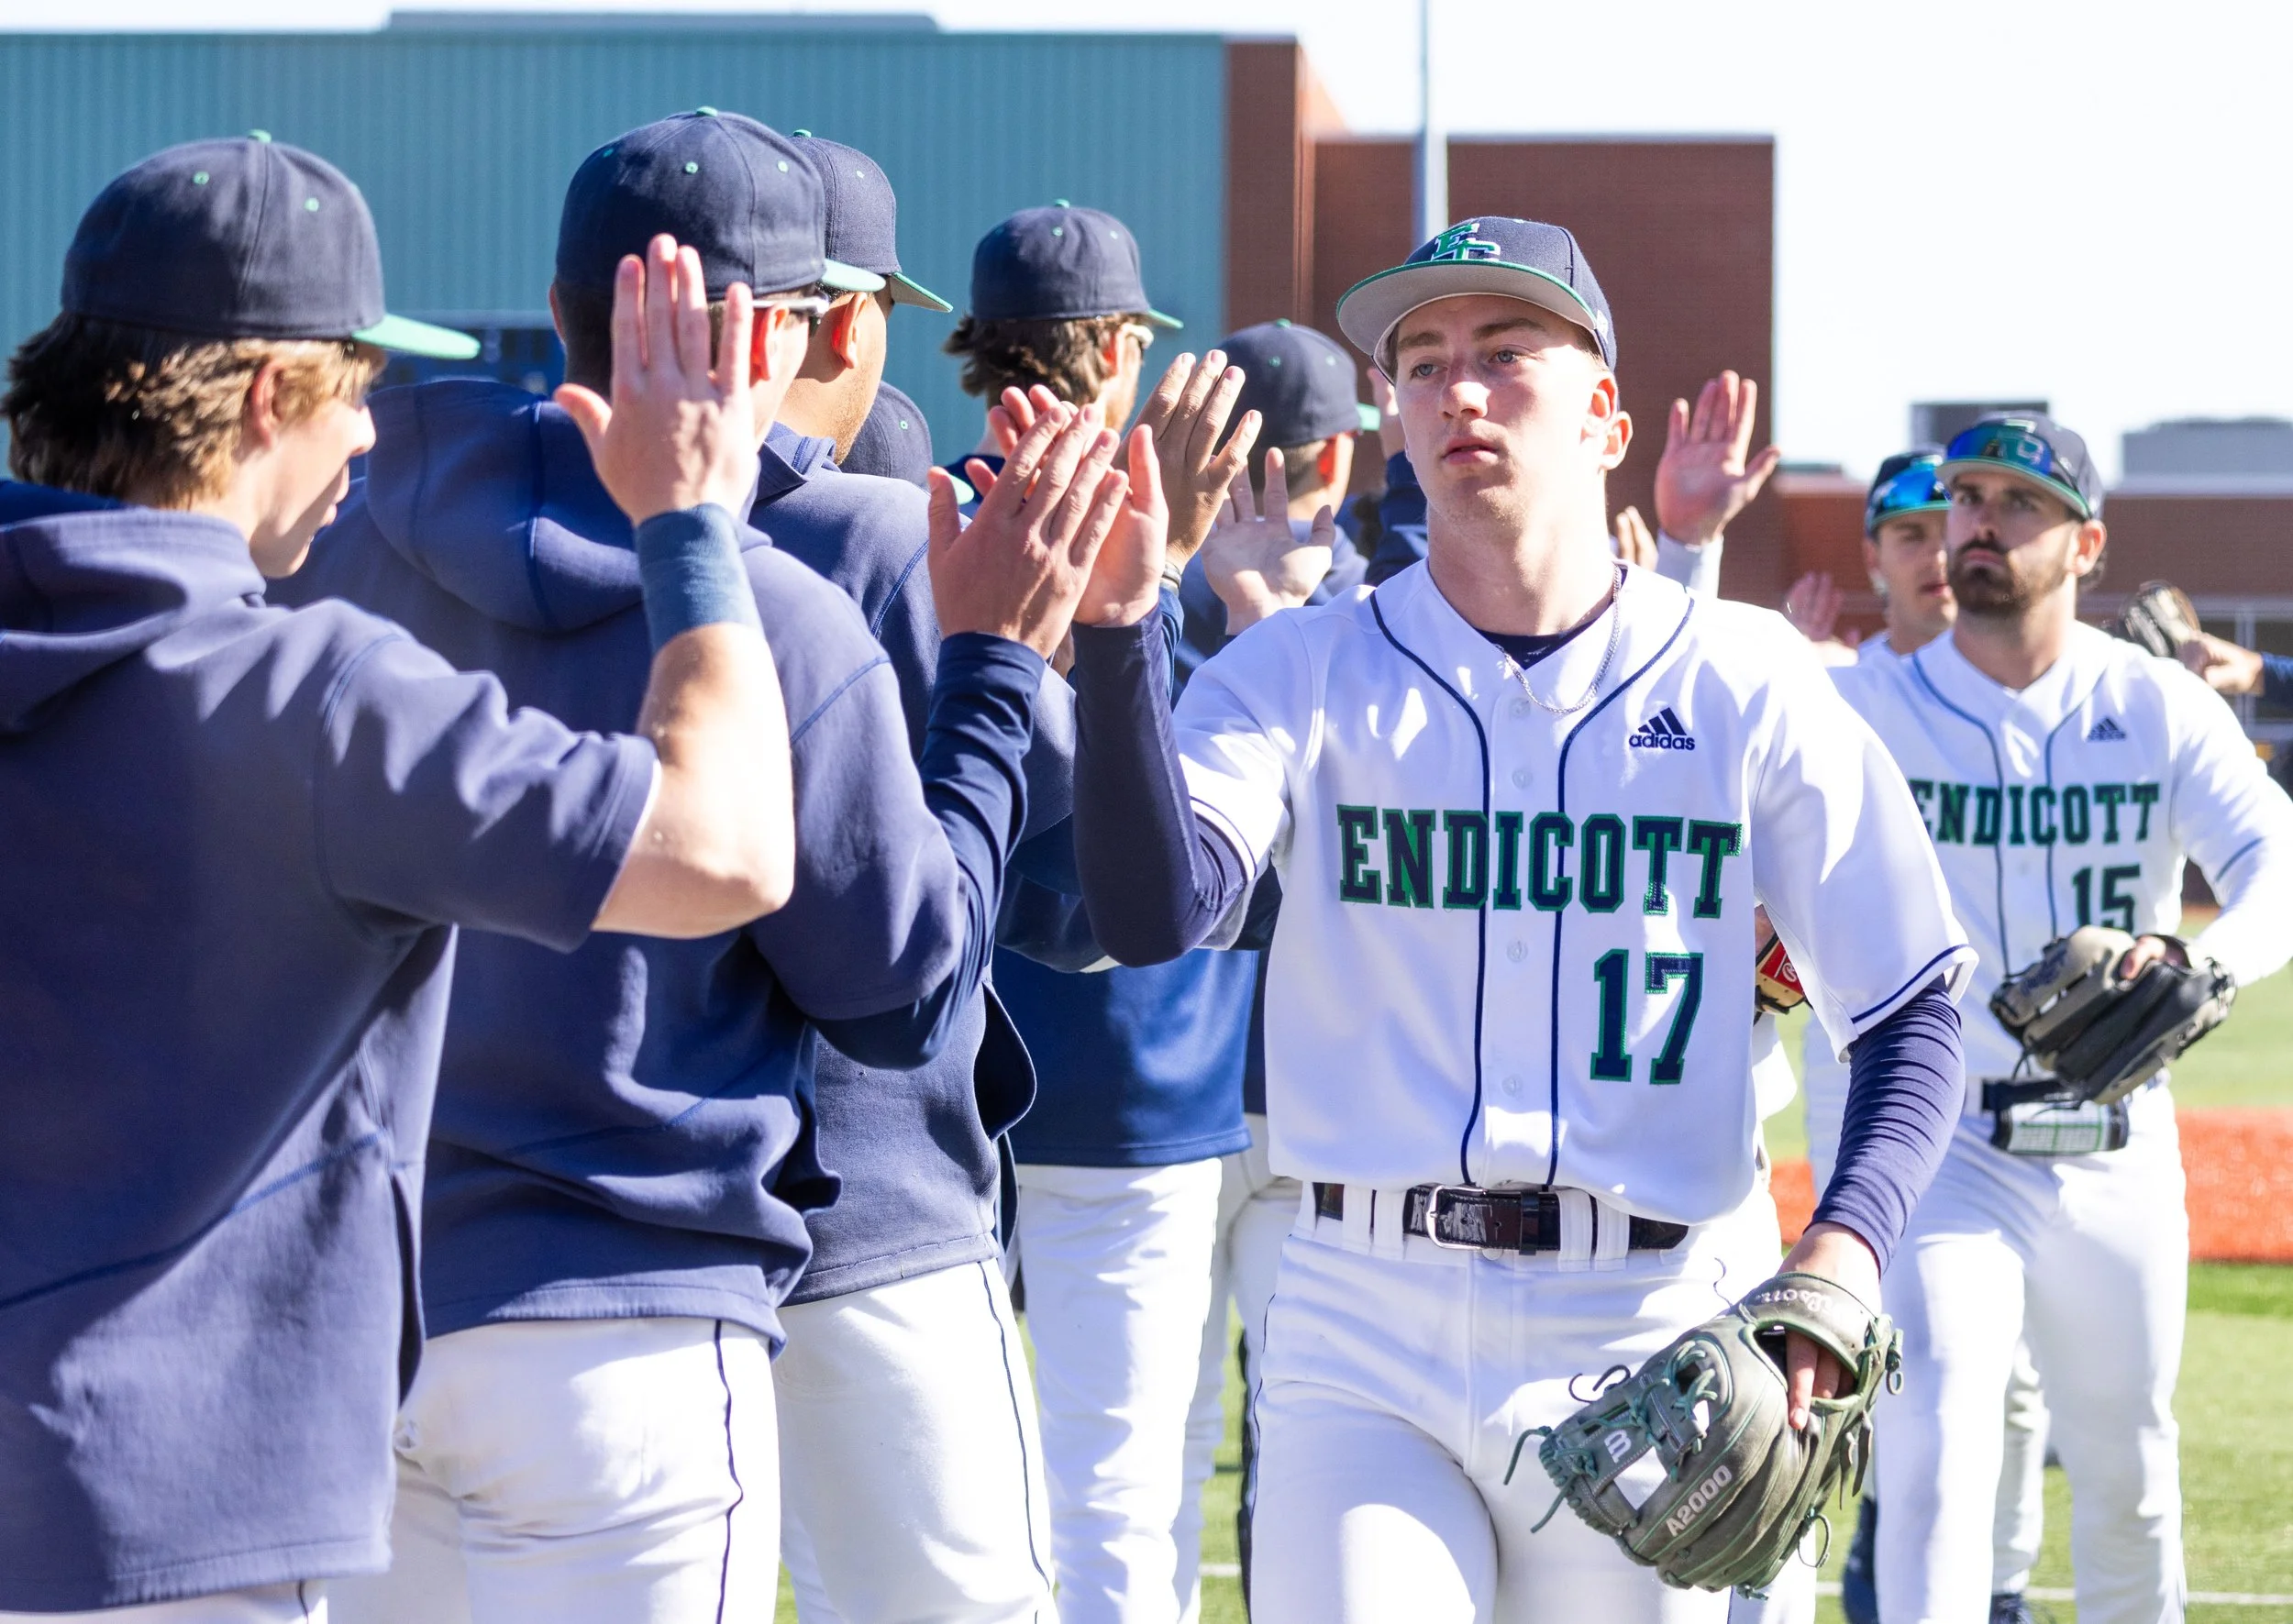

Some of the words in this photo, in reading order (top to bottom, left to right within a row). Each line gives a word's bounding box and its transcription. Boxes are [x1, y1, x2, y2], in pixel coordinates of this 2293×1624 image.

[1629, 732, 1695, 751] adidas
[1336, 804, 1743, 919] ENDICOTT
[2072, 864, 2140, 934] 15
[1590, 949, 1703, 1085] 17
[1760, 1288, 1837, 1314] ilson
[1666, 1464, 1733, 1537] A2000
